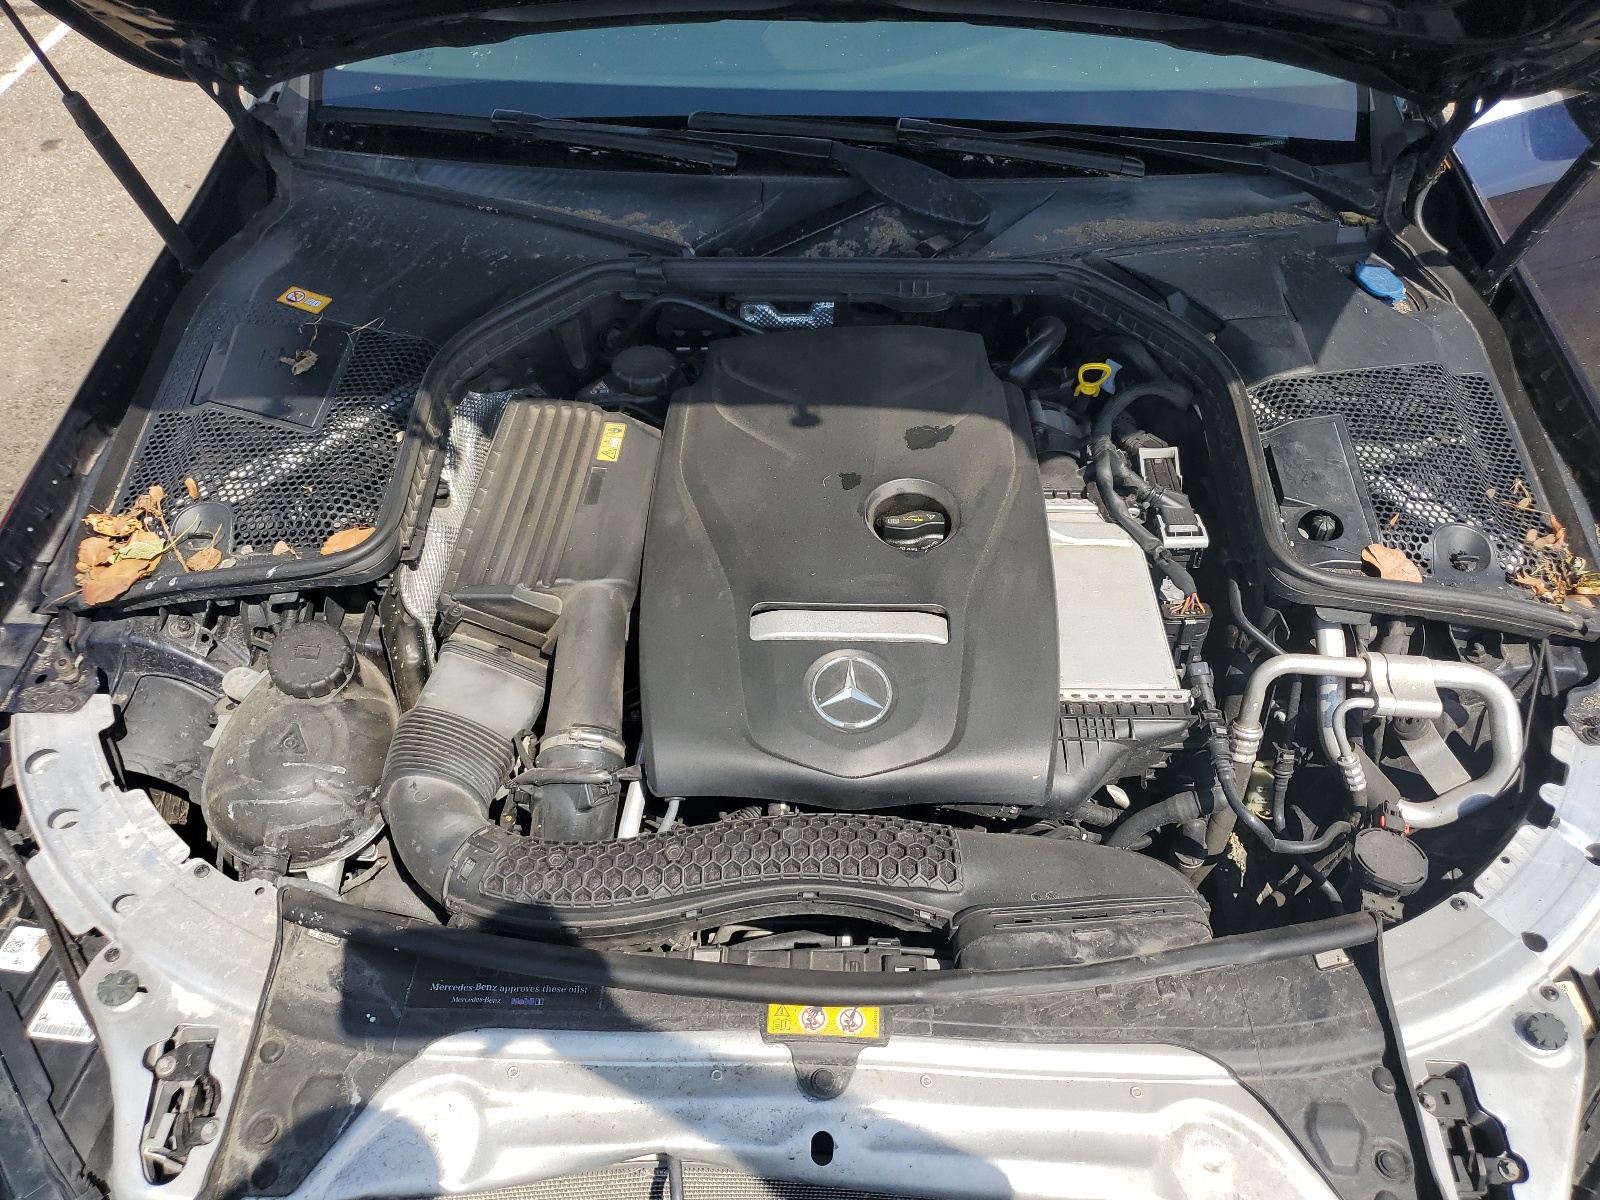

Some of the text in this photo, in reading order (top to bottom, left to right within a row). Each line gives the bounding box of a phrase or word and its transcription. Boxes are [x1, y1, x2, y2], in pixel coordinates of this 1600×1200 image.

[429, 982, 588, 994] Mercedes-Benz approves these oils:
[451, 996, 502, 1004] Mercedes-Benz
